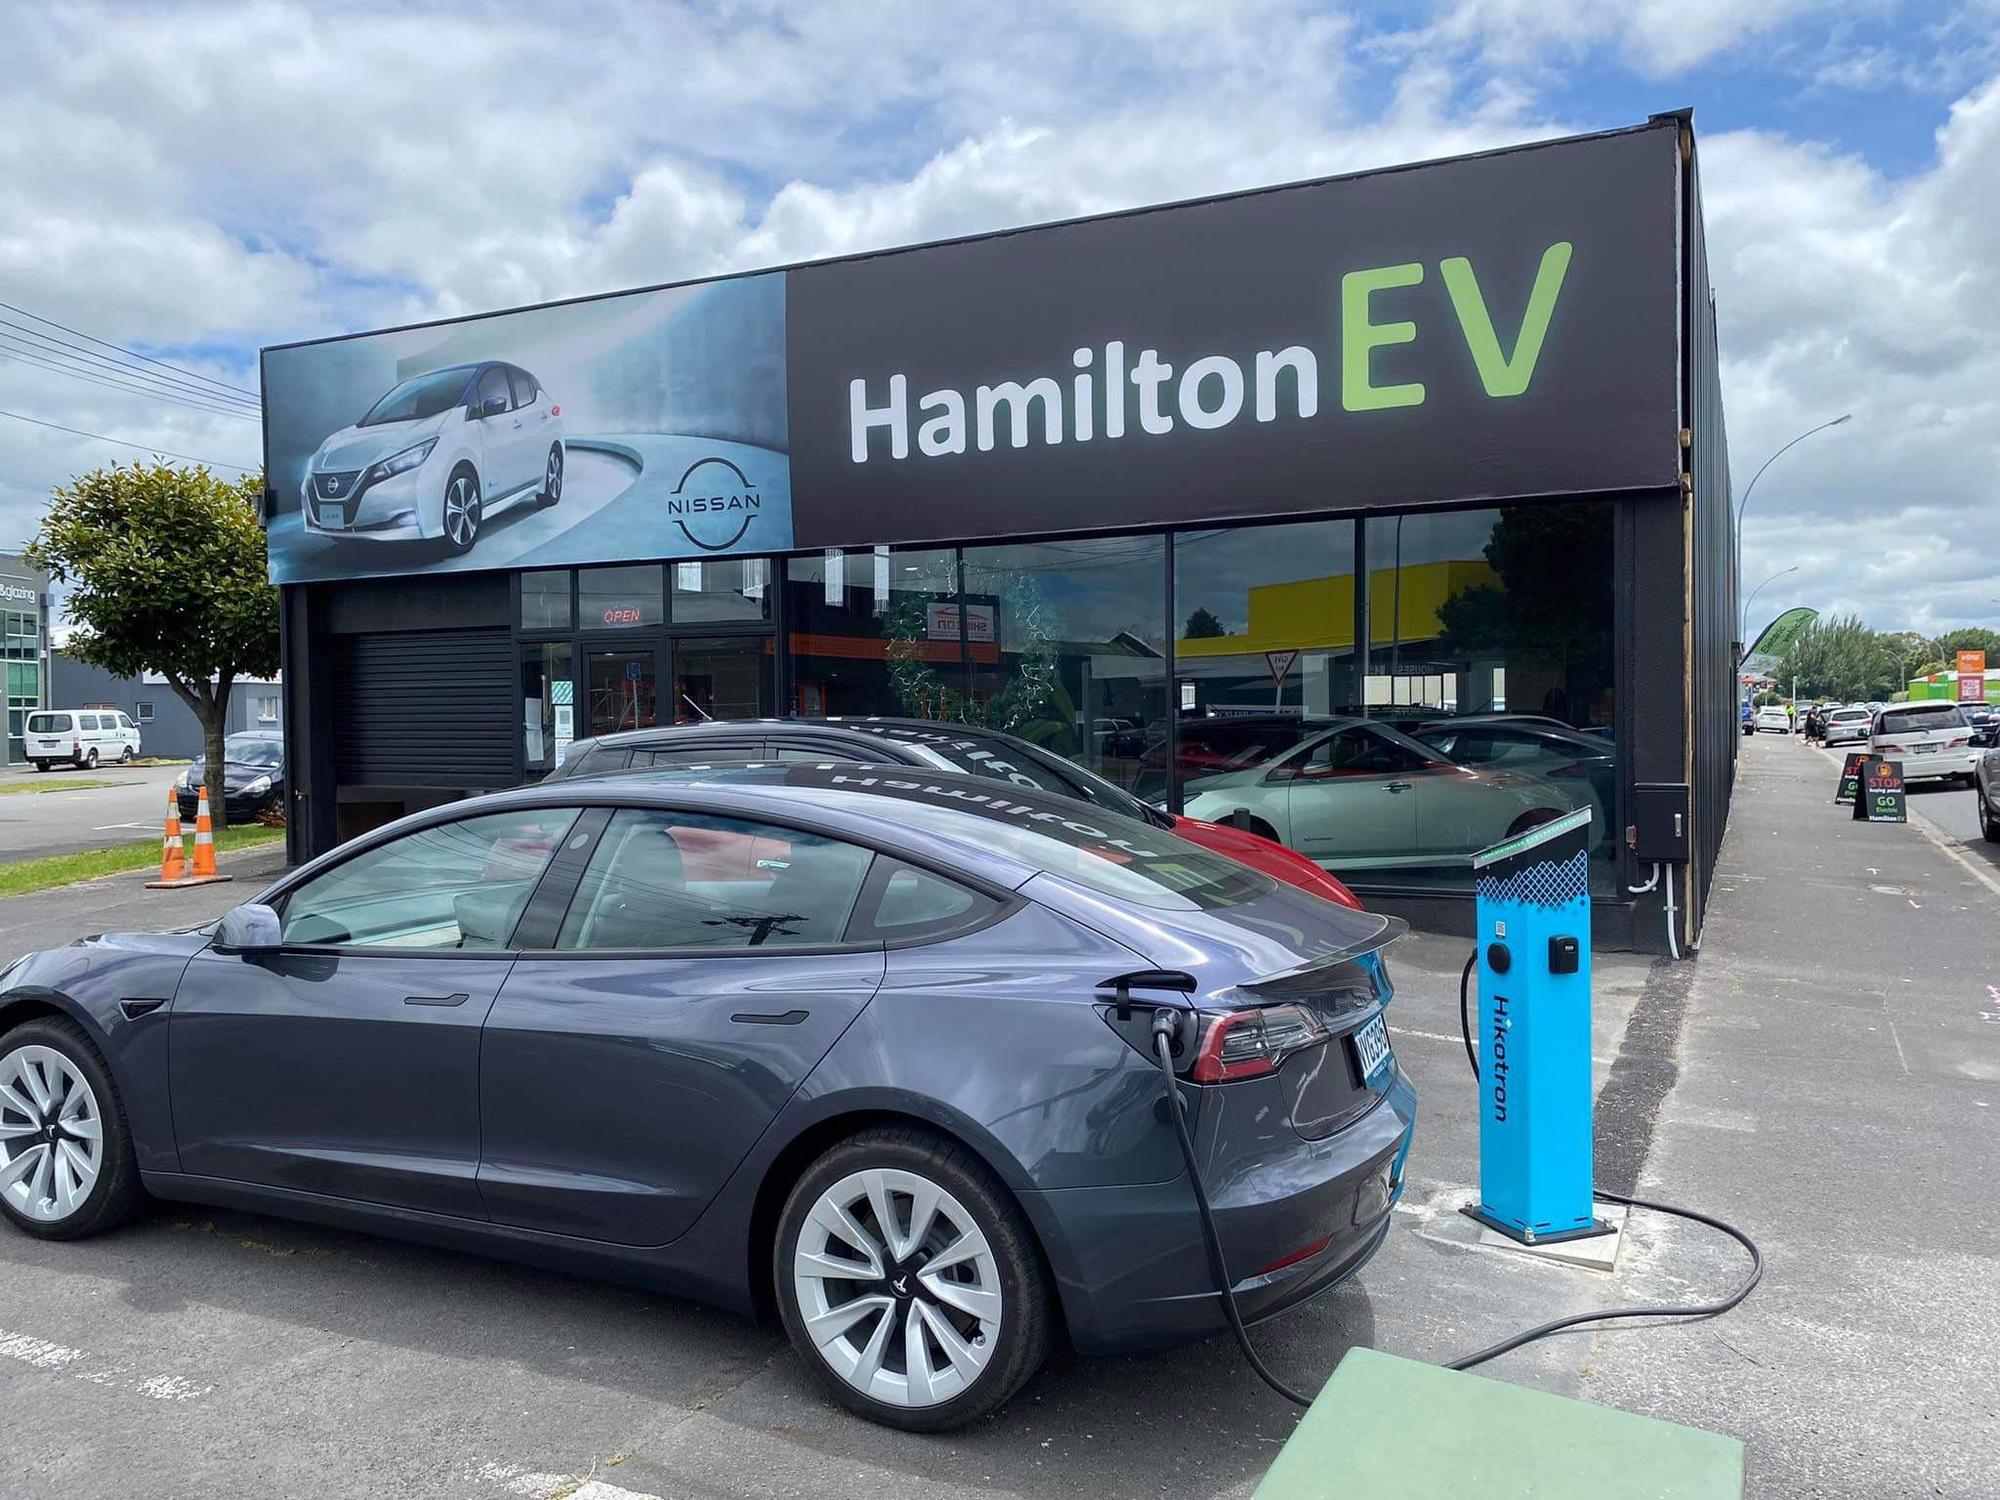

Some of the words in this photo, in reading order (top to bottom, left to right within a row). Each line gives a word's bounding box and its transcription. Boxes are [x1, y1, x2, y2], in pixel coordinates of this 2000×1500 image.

[668, 493, 760, 515] NISSAN
[603, 609, 640, 623] OPEN
[1869, 776, 1902, 789] STOP
[1877, 796, 1896, 807] GO
[1493, 994, 1511, 1123] Hikotron
